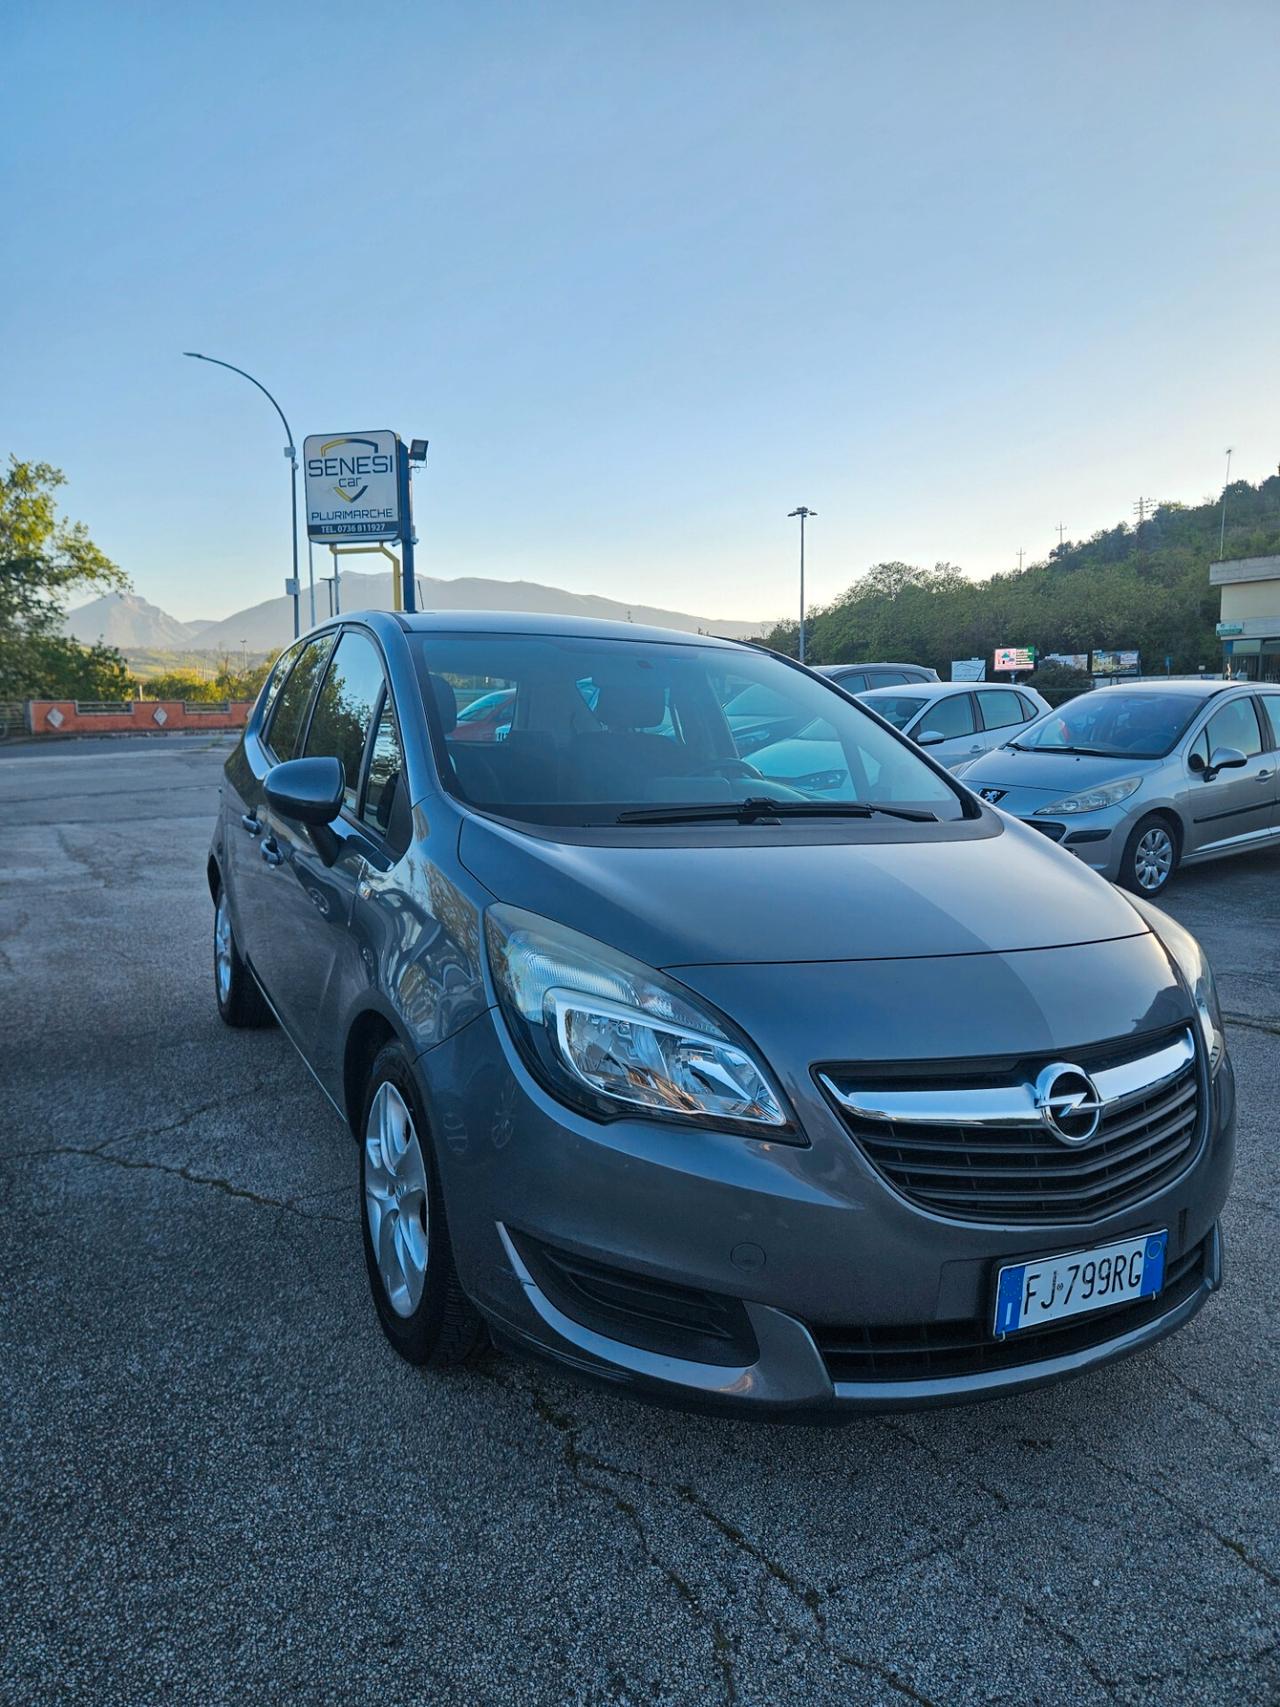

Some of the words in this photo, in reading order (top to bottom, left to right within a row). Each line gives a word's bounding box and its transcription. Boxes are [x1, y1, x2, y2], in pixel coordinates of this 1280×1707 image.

[308, 455, 393, 477] SENESI
[338, 477, 362, 488] car
[311, 508, 393, 521] PLURIMARCHE
